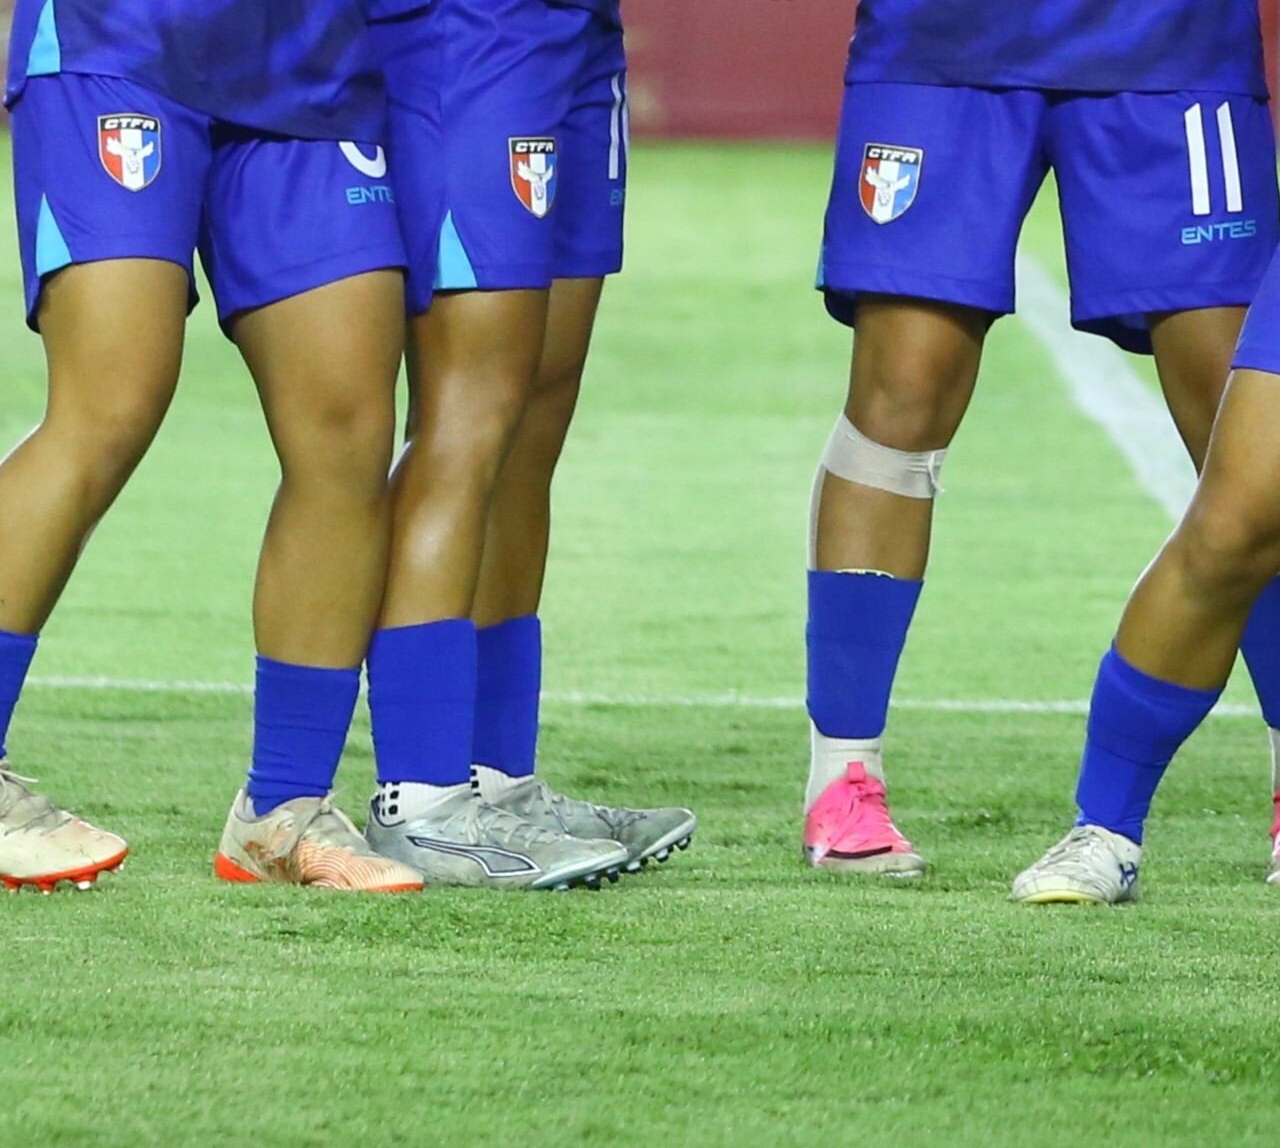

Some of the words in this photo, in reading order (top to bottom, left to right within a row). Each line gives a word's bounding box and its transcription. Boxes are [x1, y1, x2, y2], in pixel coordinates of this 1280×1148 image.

[104, 118, 155, 130] CTFA
[515, 142, 553, 153] CTFA
[868, 147, 916, 163] CTFA
[1184, 101, 1243, 215] 11
[345, 184, 395, 205] ENTE
[1181, 220, 1256, 244] ENTES
